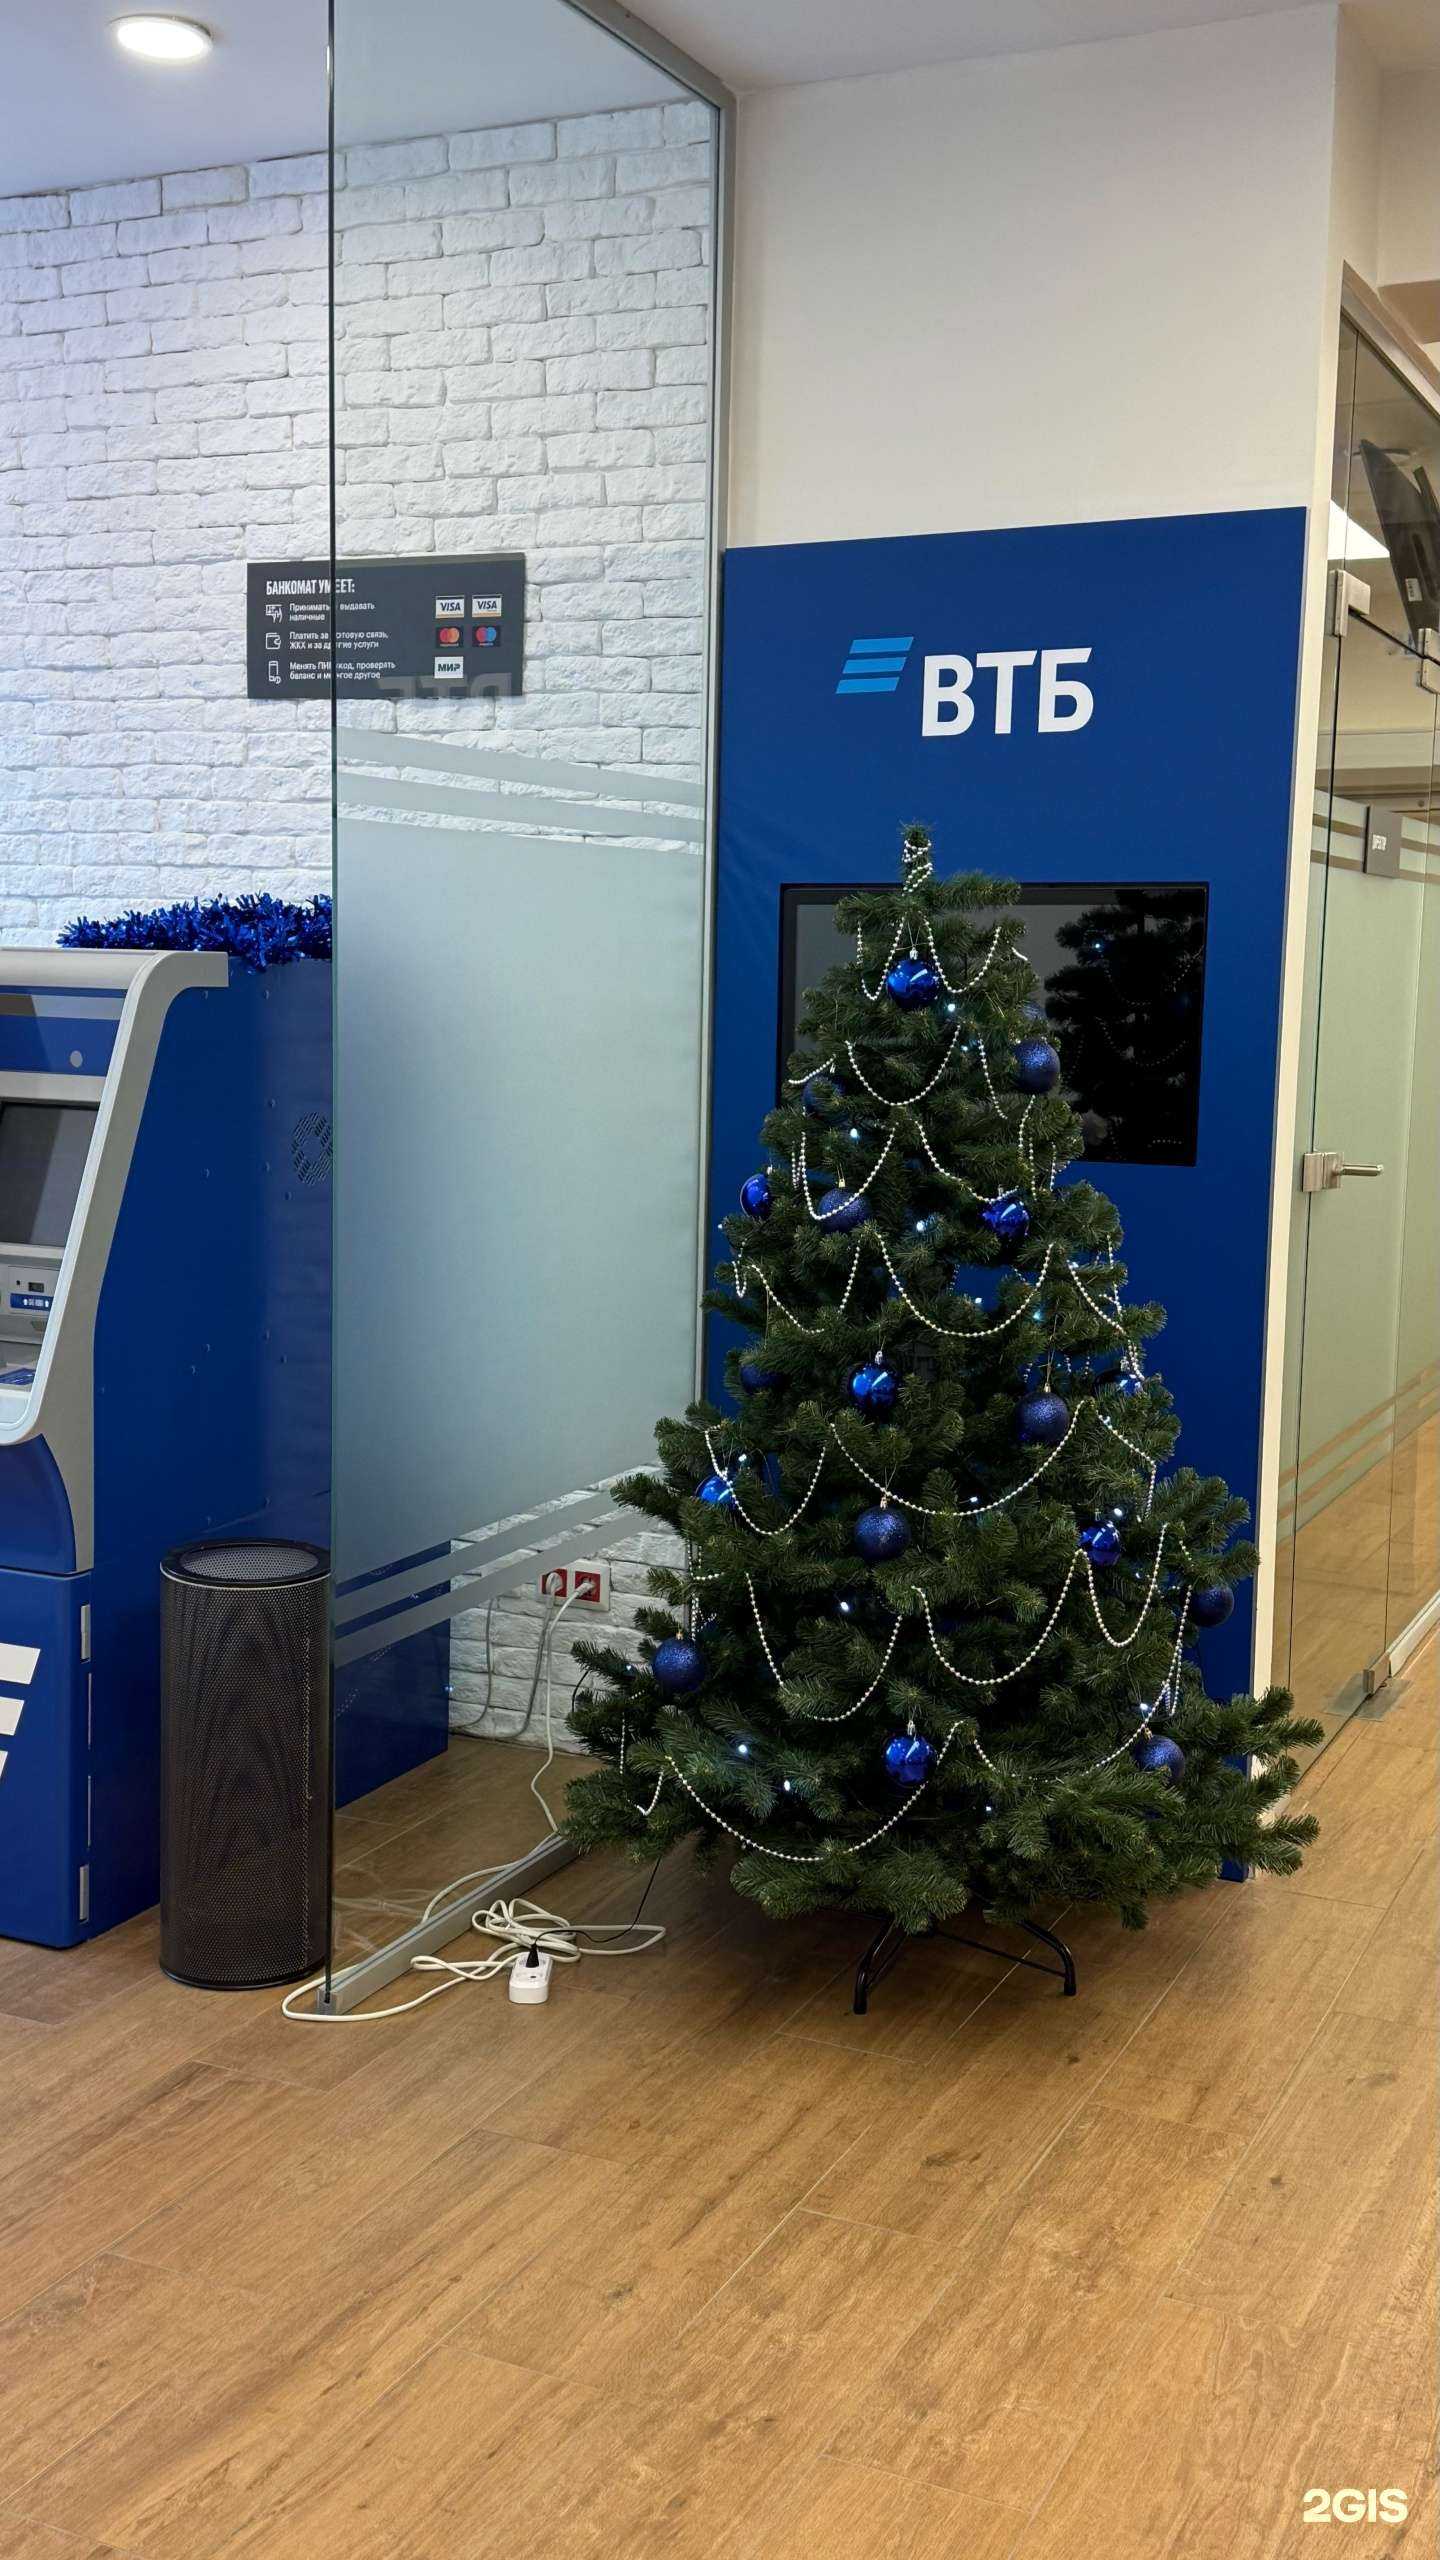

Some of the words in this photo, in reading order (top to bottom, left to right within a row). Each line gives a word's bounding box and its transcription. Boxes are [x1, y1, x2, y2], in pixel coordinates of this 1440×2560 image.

[266, 580, 317, 595] БАНКОМАТ
[318, 578, 355, 594] УМЕЕТ:
[289, 603, 330, 613] Принимать
[339, 603, 376, 612] выдавать
[440, 602, 461, 612] VISA
[477, 600, 498, 610] VISA
[289, 631, 318, 640] Платить
[320, 632, 329, 640] за
[334, 631, 365, 641] отовую
[289, 641, 306, 650] ЖКХ
[323, 641, 352, 650] дгие
[353, 641, 379, 650] услуги
[289, 661, 317, 670] Менять
[356, 661, 397, 671] проверять
[438, 663, 461, 673] МИР
[289, 670, 316, 680] баланс
[323, 672, 353, 680] мгое
[353, 671, 381, 681] другое
[922, 647, 1094, 737] ВТБ
